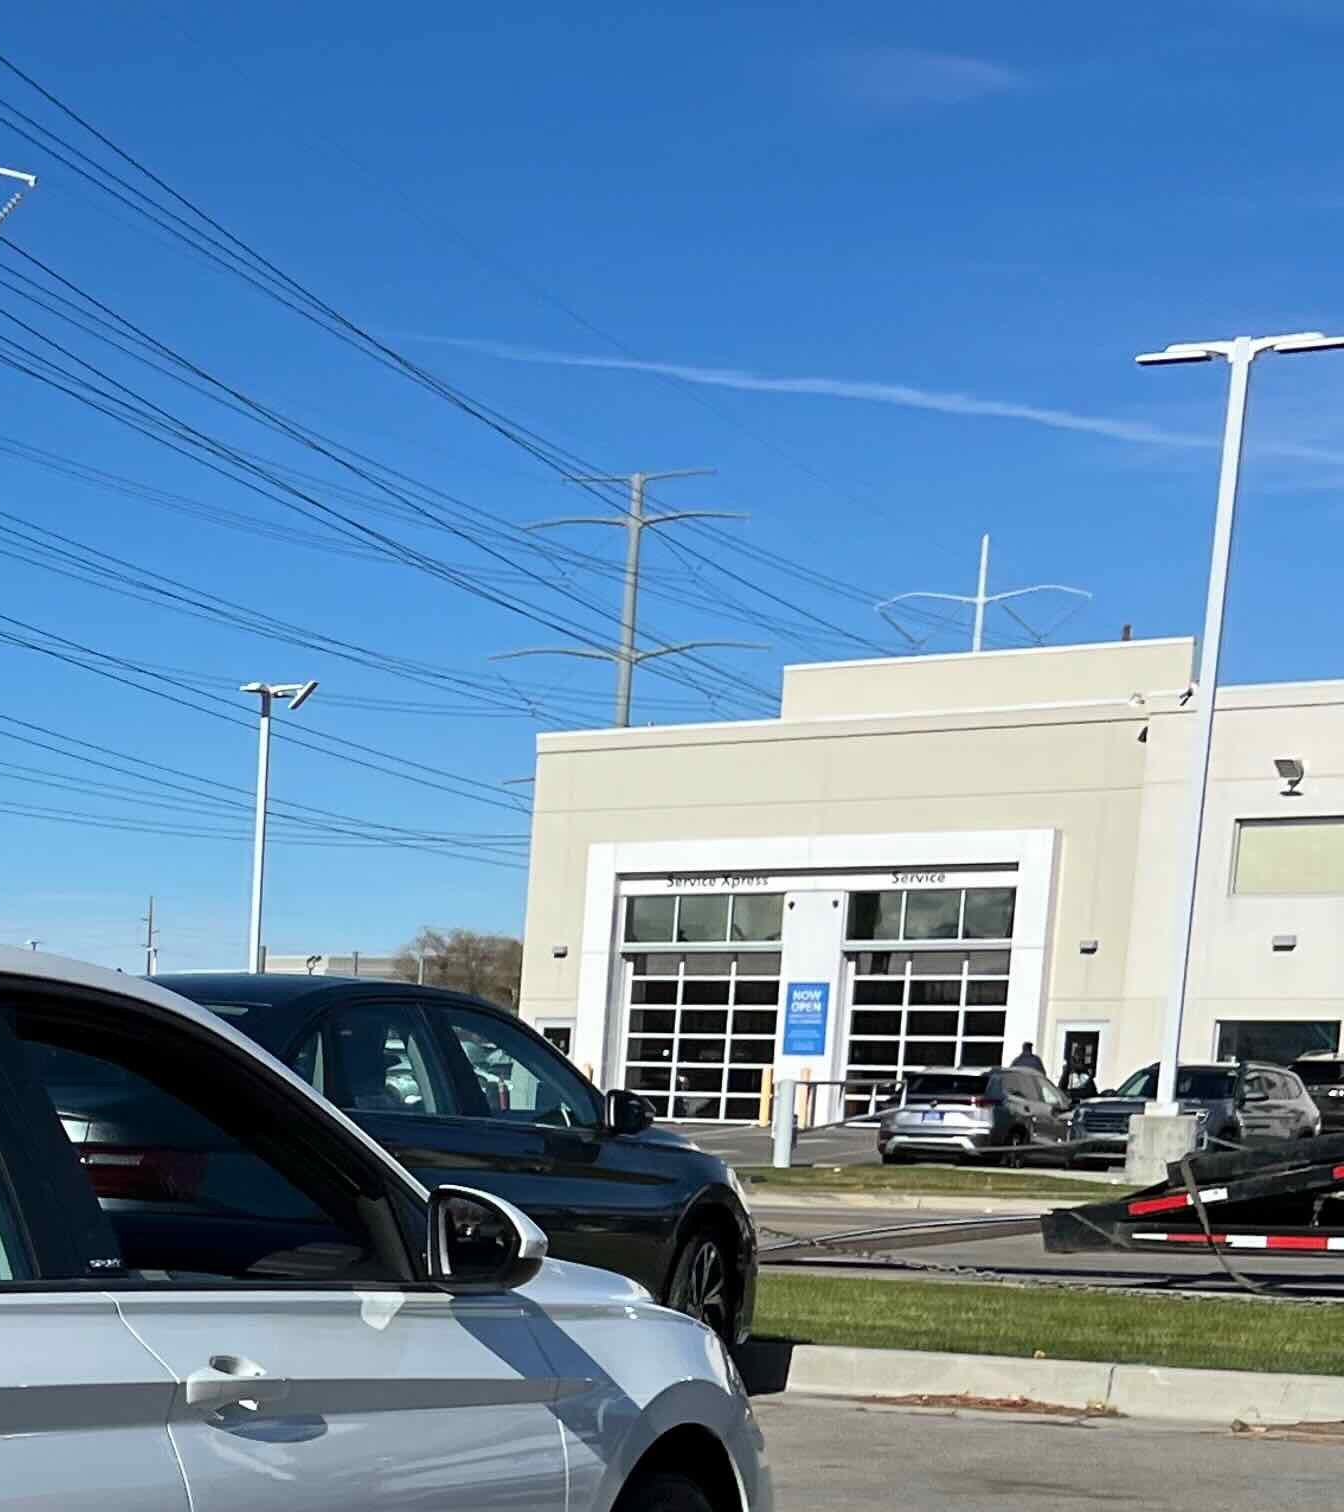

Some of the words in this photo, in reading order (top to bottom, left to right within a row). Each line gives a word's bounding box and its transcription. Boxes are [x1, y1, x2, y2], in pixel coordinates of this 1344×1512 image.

[666, 873, 716, 888] Service
[892, 871, 946, 884] Service
[792, 989, 821, 1001] NOW
[791, 1001, 821, 1012] OPEN
